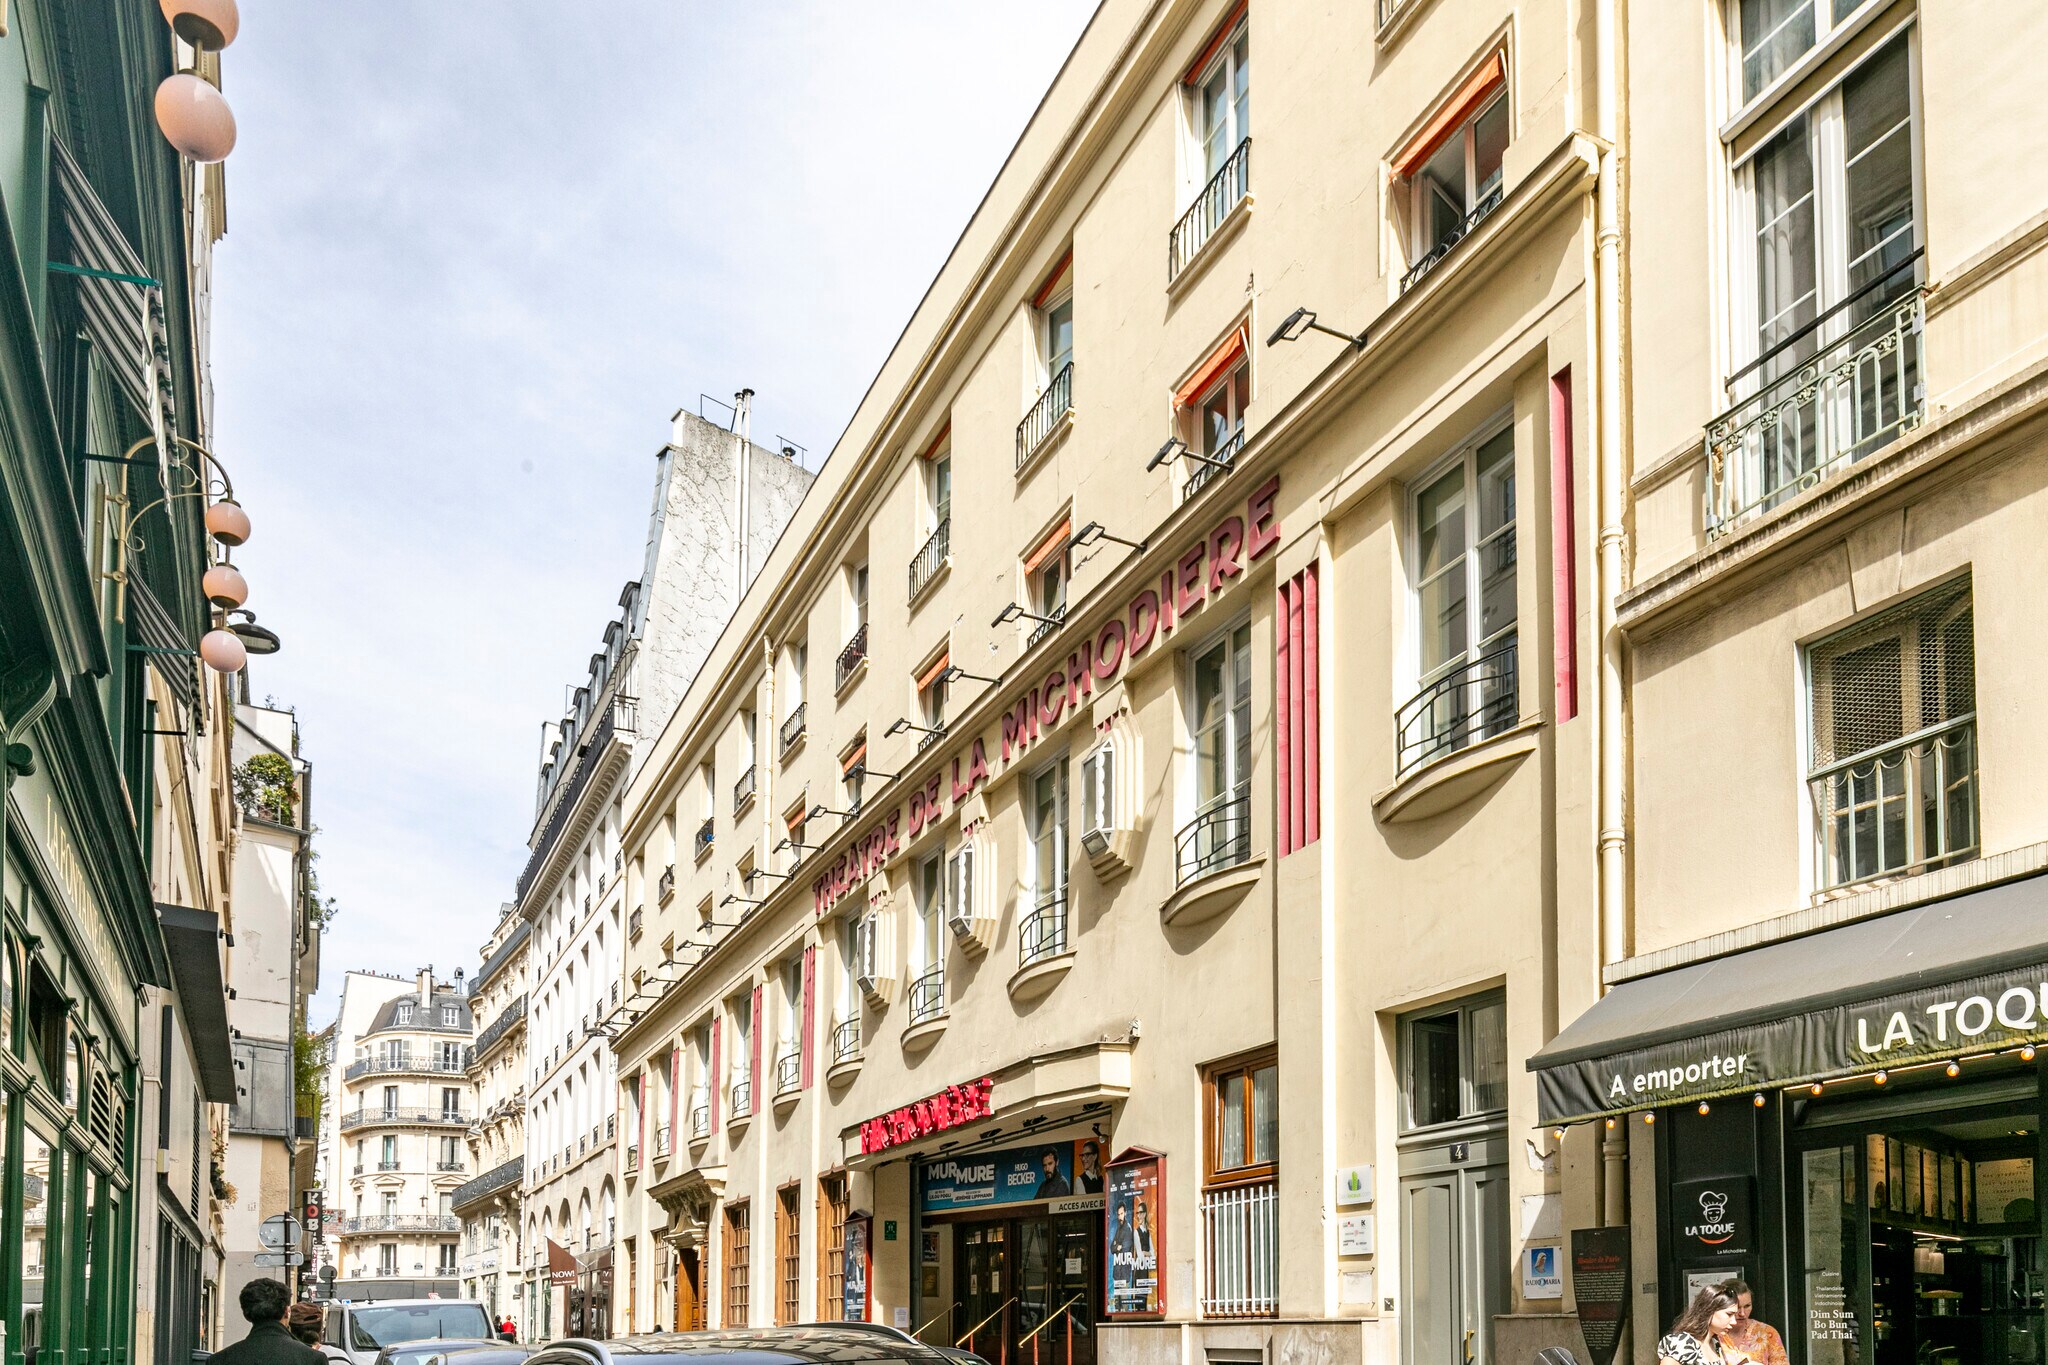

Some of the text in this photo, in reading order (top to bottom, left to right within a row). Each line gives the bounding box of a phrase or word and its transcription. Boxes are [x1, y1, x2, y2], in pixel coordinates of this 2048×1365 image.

[909, 773, 942, 838] DE
[952, 738, 990, 803] LA
[1001, 472, 1281, 763] MICHODIERE
[1858, 982, 2048, 1053] LA TOQ
[1610, 1053, 1747, 1098] A emporter
[1455, 1144, 1463, 1159] 4
[1014, 1162, 1029, 1172] HUGO
[1007, 1171, 1036, 1186] BECKER
[1058, 1202, 1079, 1211] ACCES
[1080, 1200, 1098, 1209] AVEC
[1685, 1223, 1735, 1236] LA TOQUE
[551, 1270, 575, 1278] NOW!
[1810, 1309, 1854, 1319] Dim Sum
[1814, 1320, 1848, 1329] Bo Bun
[1811, 1329, 1853, 1339] Pad Thai
